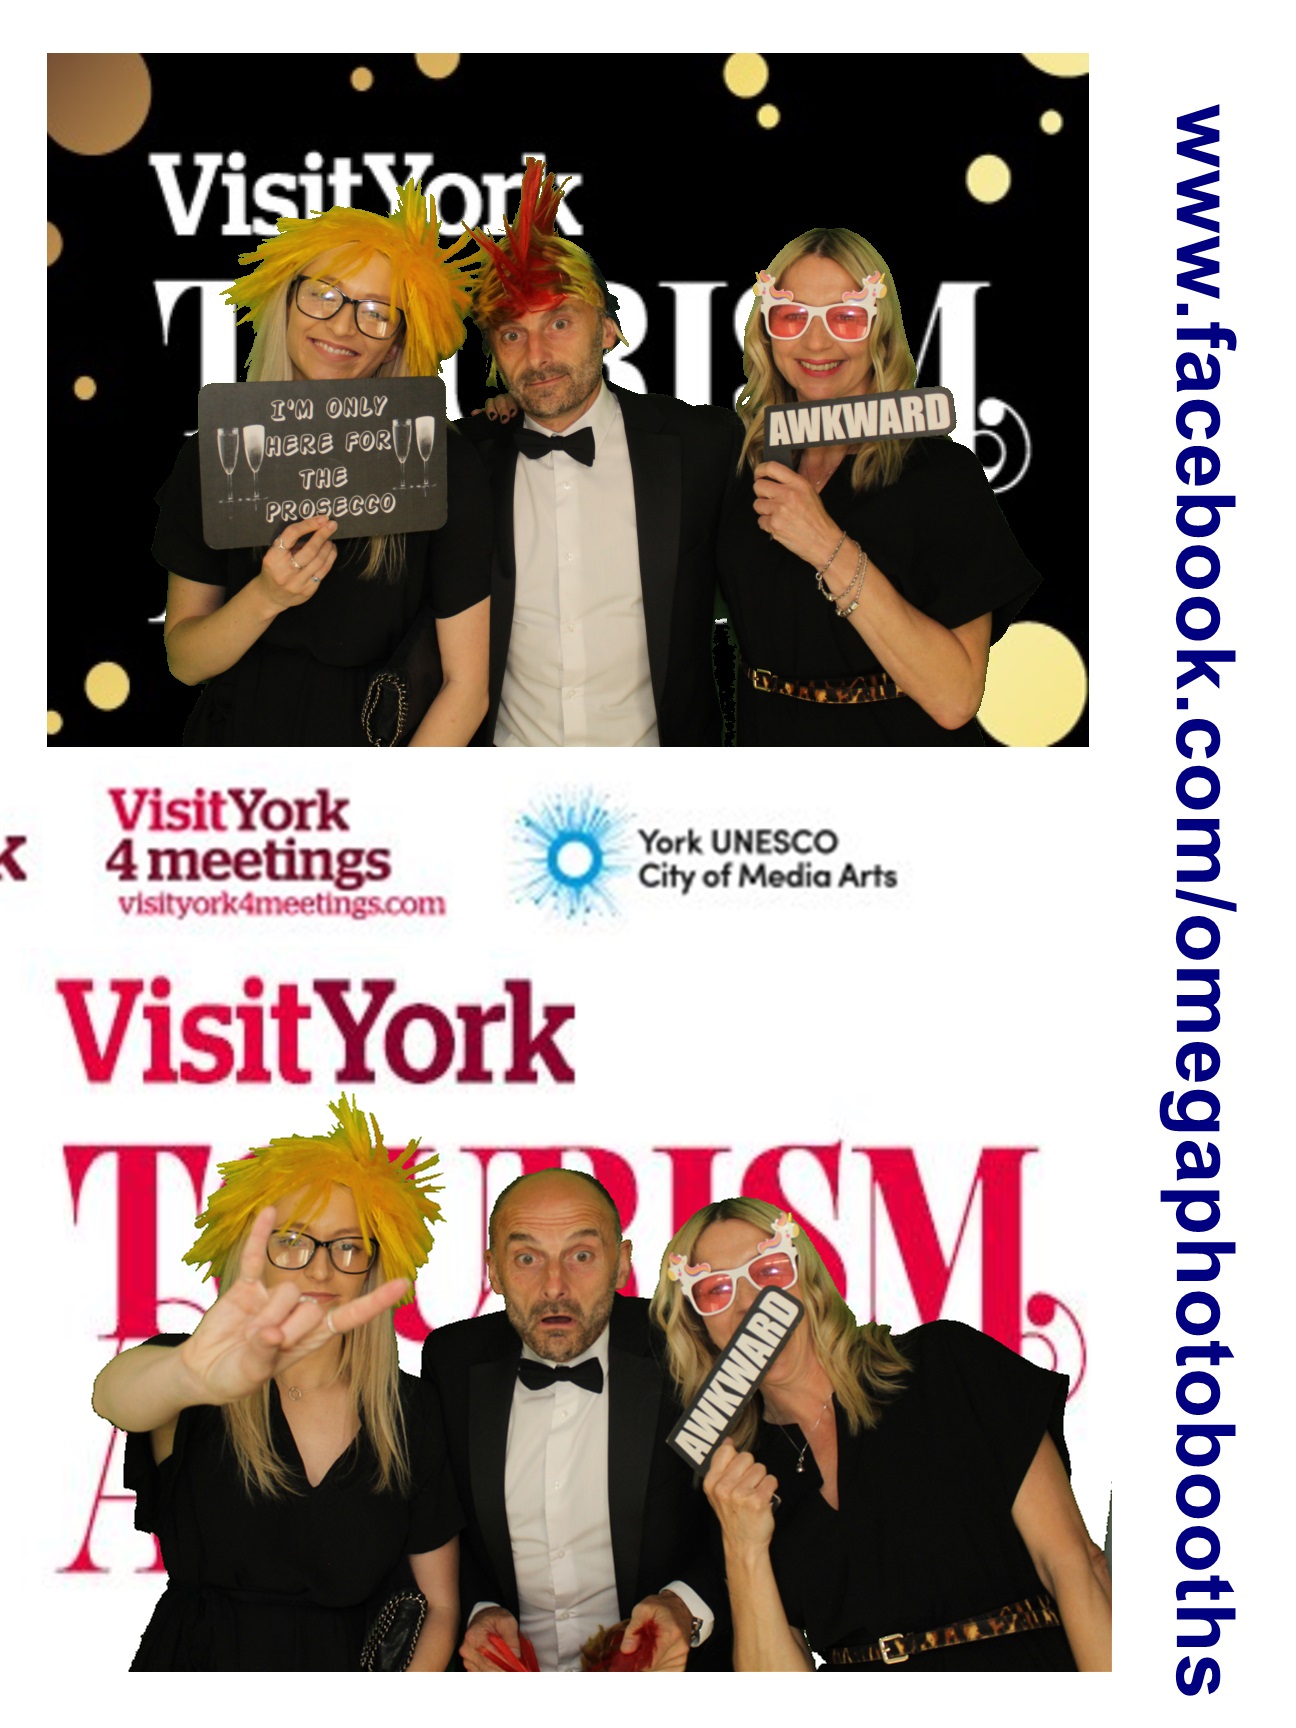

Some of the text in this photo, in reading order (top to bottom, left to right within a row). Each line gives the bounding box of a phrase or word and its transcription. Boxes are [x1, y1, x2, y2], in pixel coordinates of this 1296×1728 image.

[270, 395, 388, 422] I'M ONLY
[769, 393, 951, 447] AWKWARD
[265, 429, 392, 457] HERE FOR
[299, 467, 348, 490] THE
[265, 493, 396, 523] PROSECCO
[675, 1291, 799, 1465] AWKWARD
